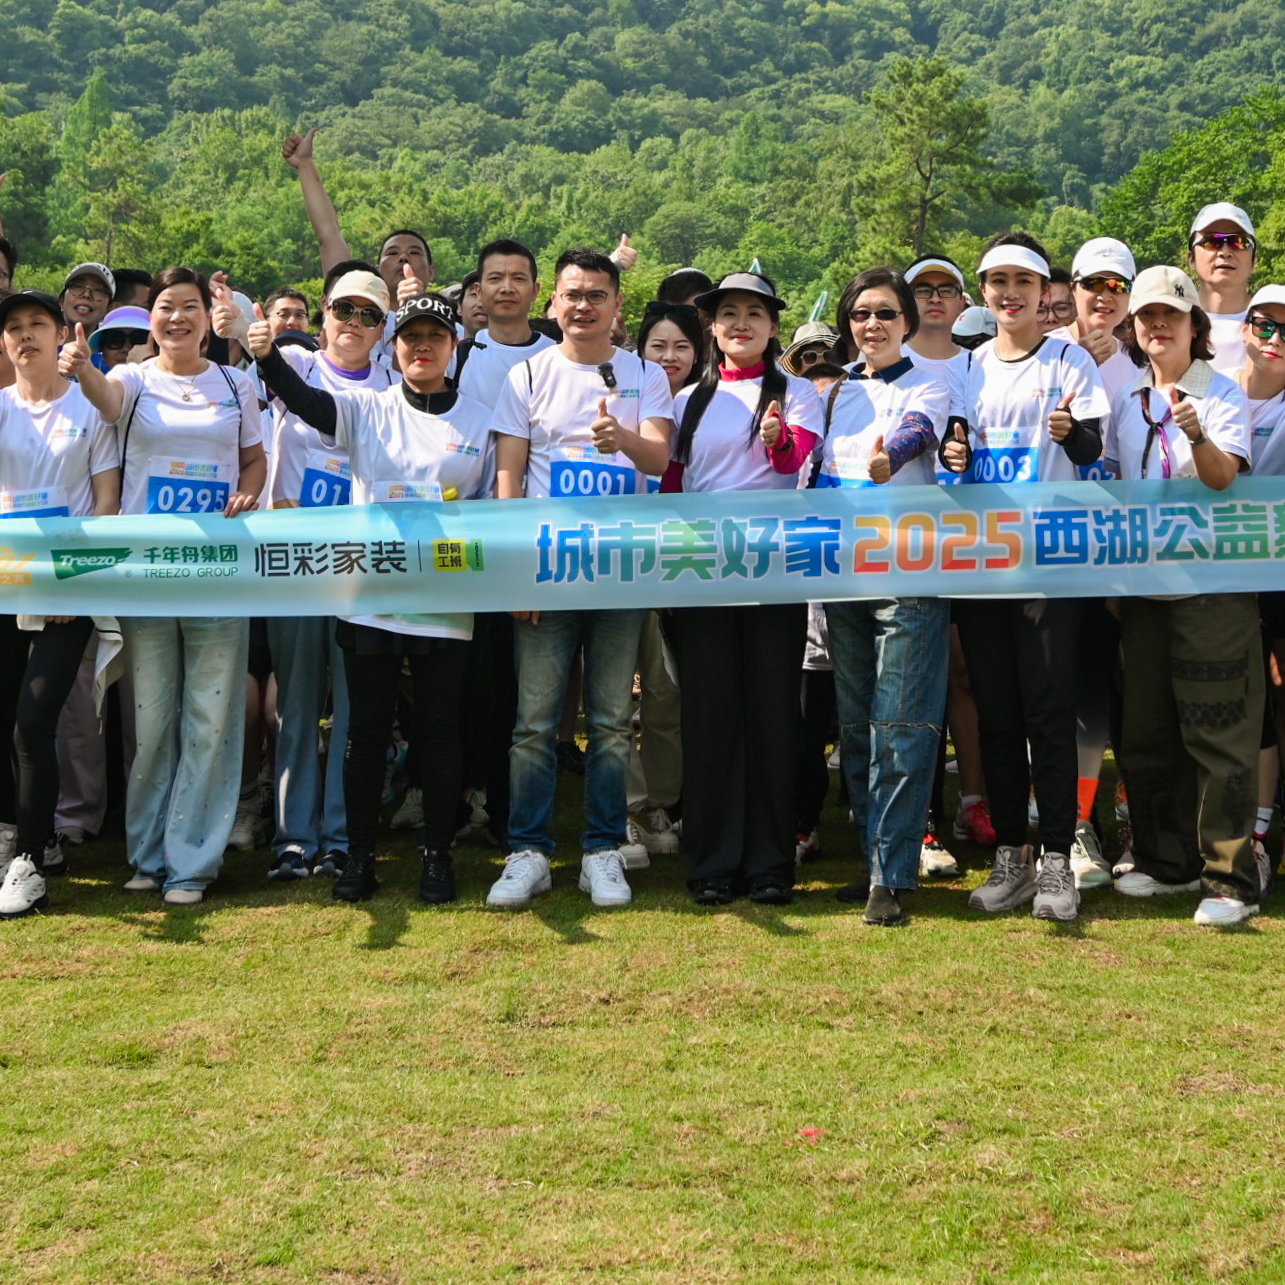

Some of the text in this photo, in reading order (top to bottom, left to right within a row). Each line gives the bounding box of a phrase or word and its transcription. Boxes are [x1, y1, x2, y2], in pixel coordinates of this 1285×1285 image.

[396, 297, 453, 322] SPORT
[559, 469, 626, 495] 0001
[157, 485, 225, 513] 0295
[143, 544, 239, 564] 千年舟集团
[254, 540, 408, 578] 恒彩家装
[535, 515, 843, 584] 城市美好家
[852, 511, 1022, 574] 2025
[60, 554, 116, 567] Treezo
[143, 566, 239, 579] TREEZO GROUP
